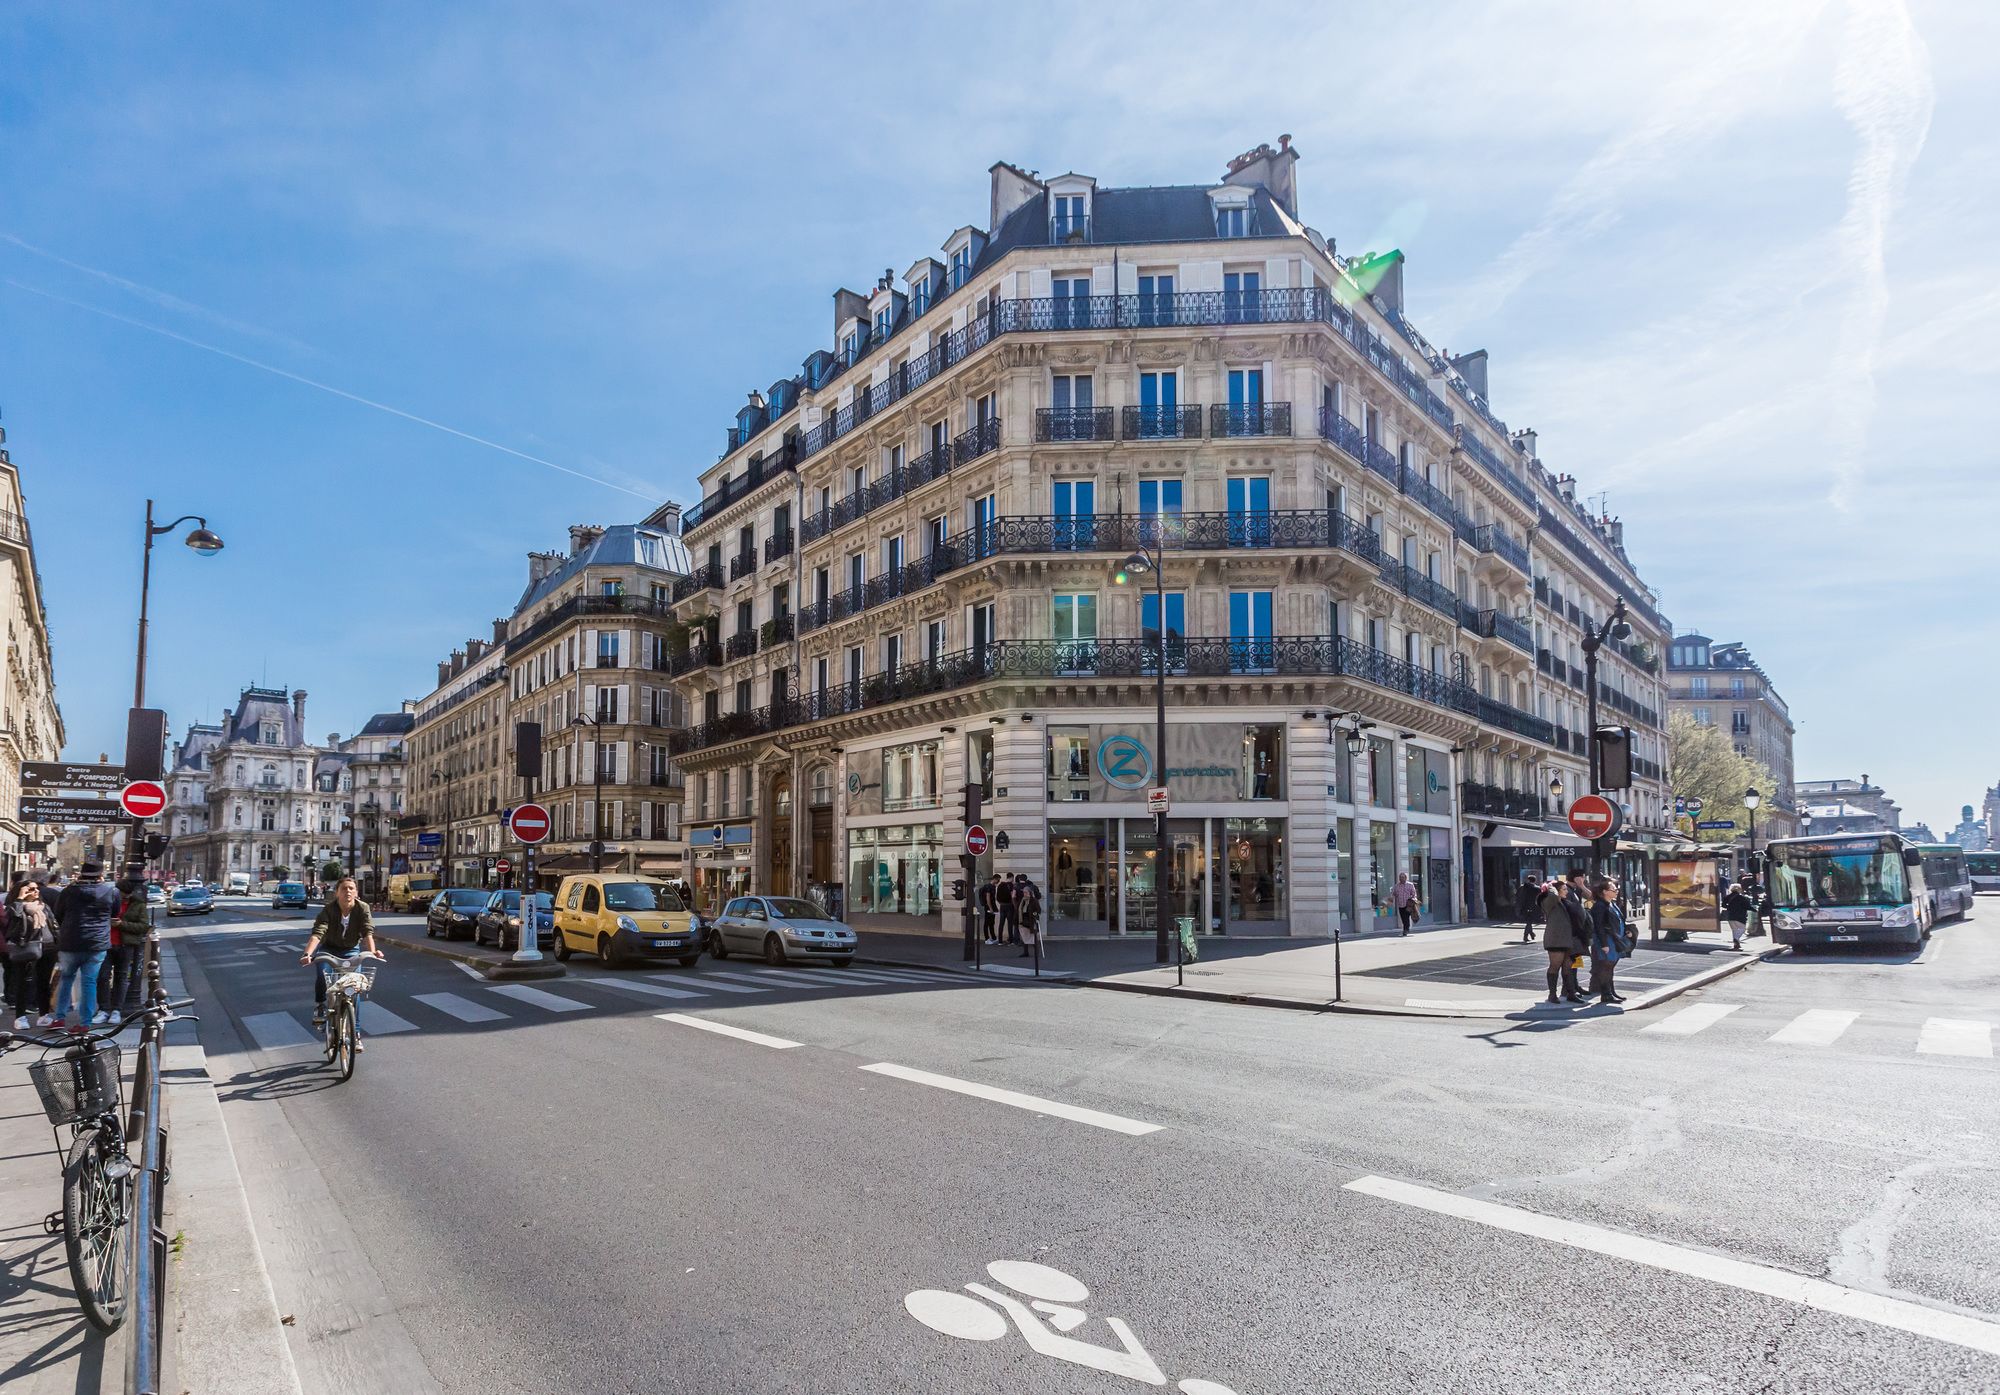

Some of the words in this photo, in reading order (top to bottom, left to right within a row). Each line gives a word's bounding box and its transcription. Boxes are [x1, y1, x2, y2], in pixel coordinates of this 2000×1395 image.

[42, 779, 71, 787] Quartier
[36, 807, 117, 816] WALLONIE-BRUXELLES
[1524, 848, 1545, 856] CAFE
[1547, 848, 1575, 856] LIVRES
